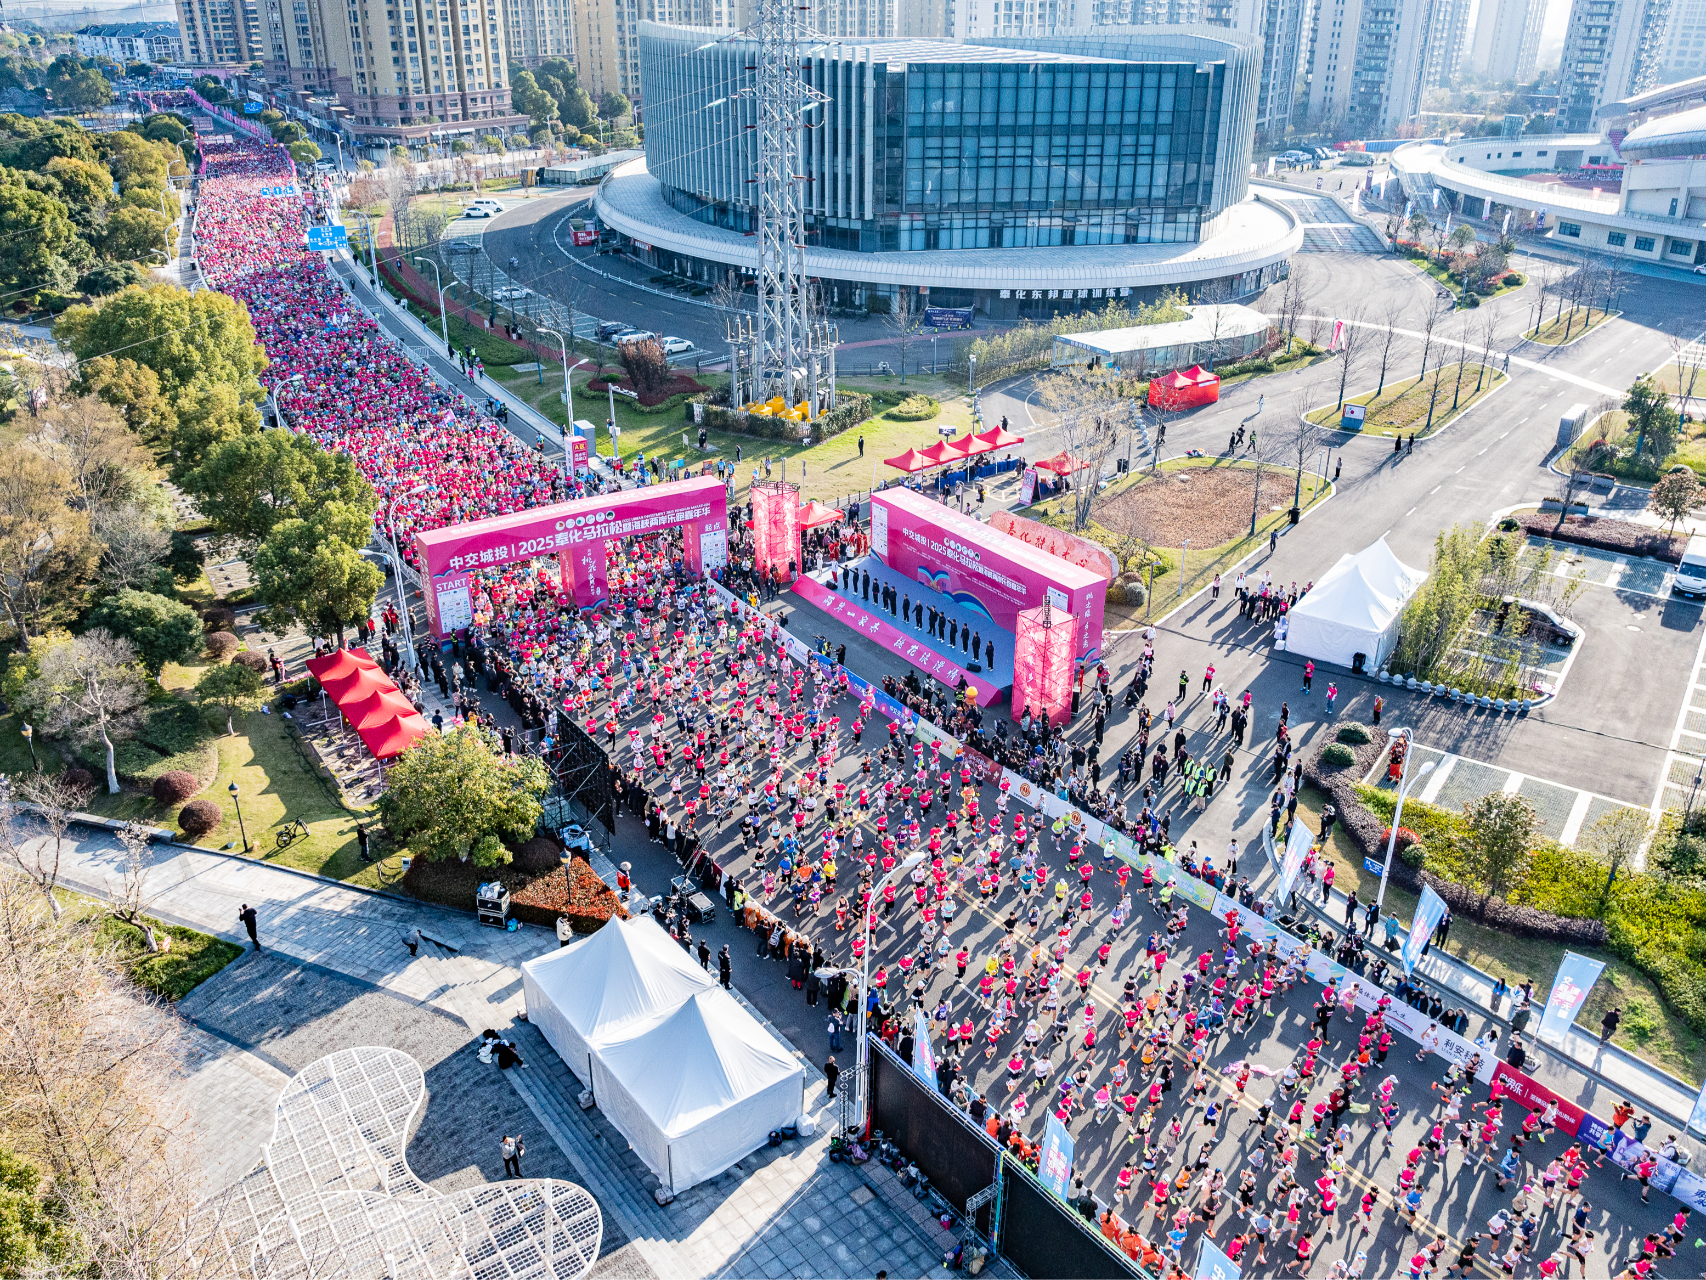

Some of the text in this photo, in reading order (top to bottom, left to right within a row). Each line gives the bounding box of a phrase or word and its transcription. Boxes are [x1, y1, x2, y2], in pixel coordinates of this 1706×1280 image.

[1000, 287, 1130, 300] 奉化东邦篮球训练营
[704, 521, 721, 532] 起点
[449, 545, 509, 570] 中交城投
[435, 577, 467, 592] START
[823, 595, 880, 633] 两岸一家亲
